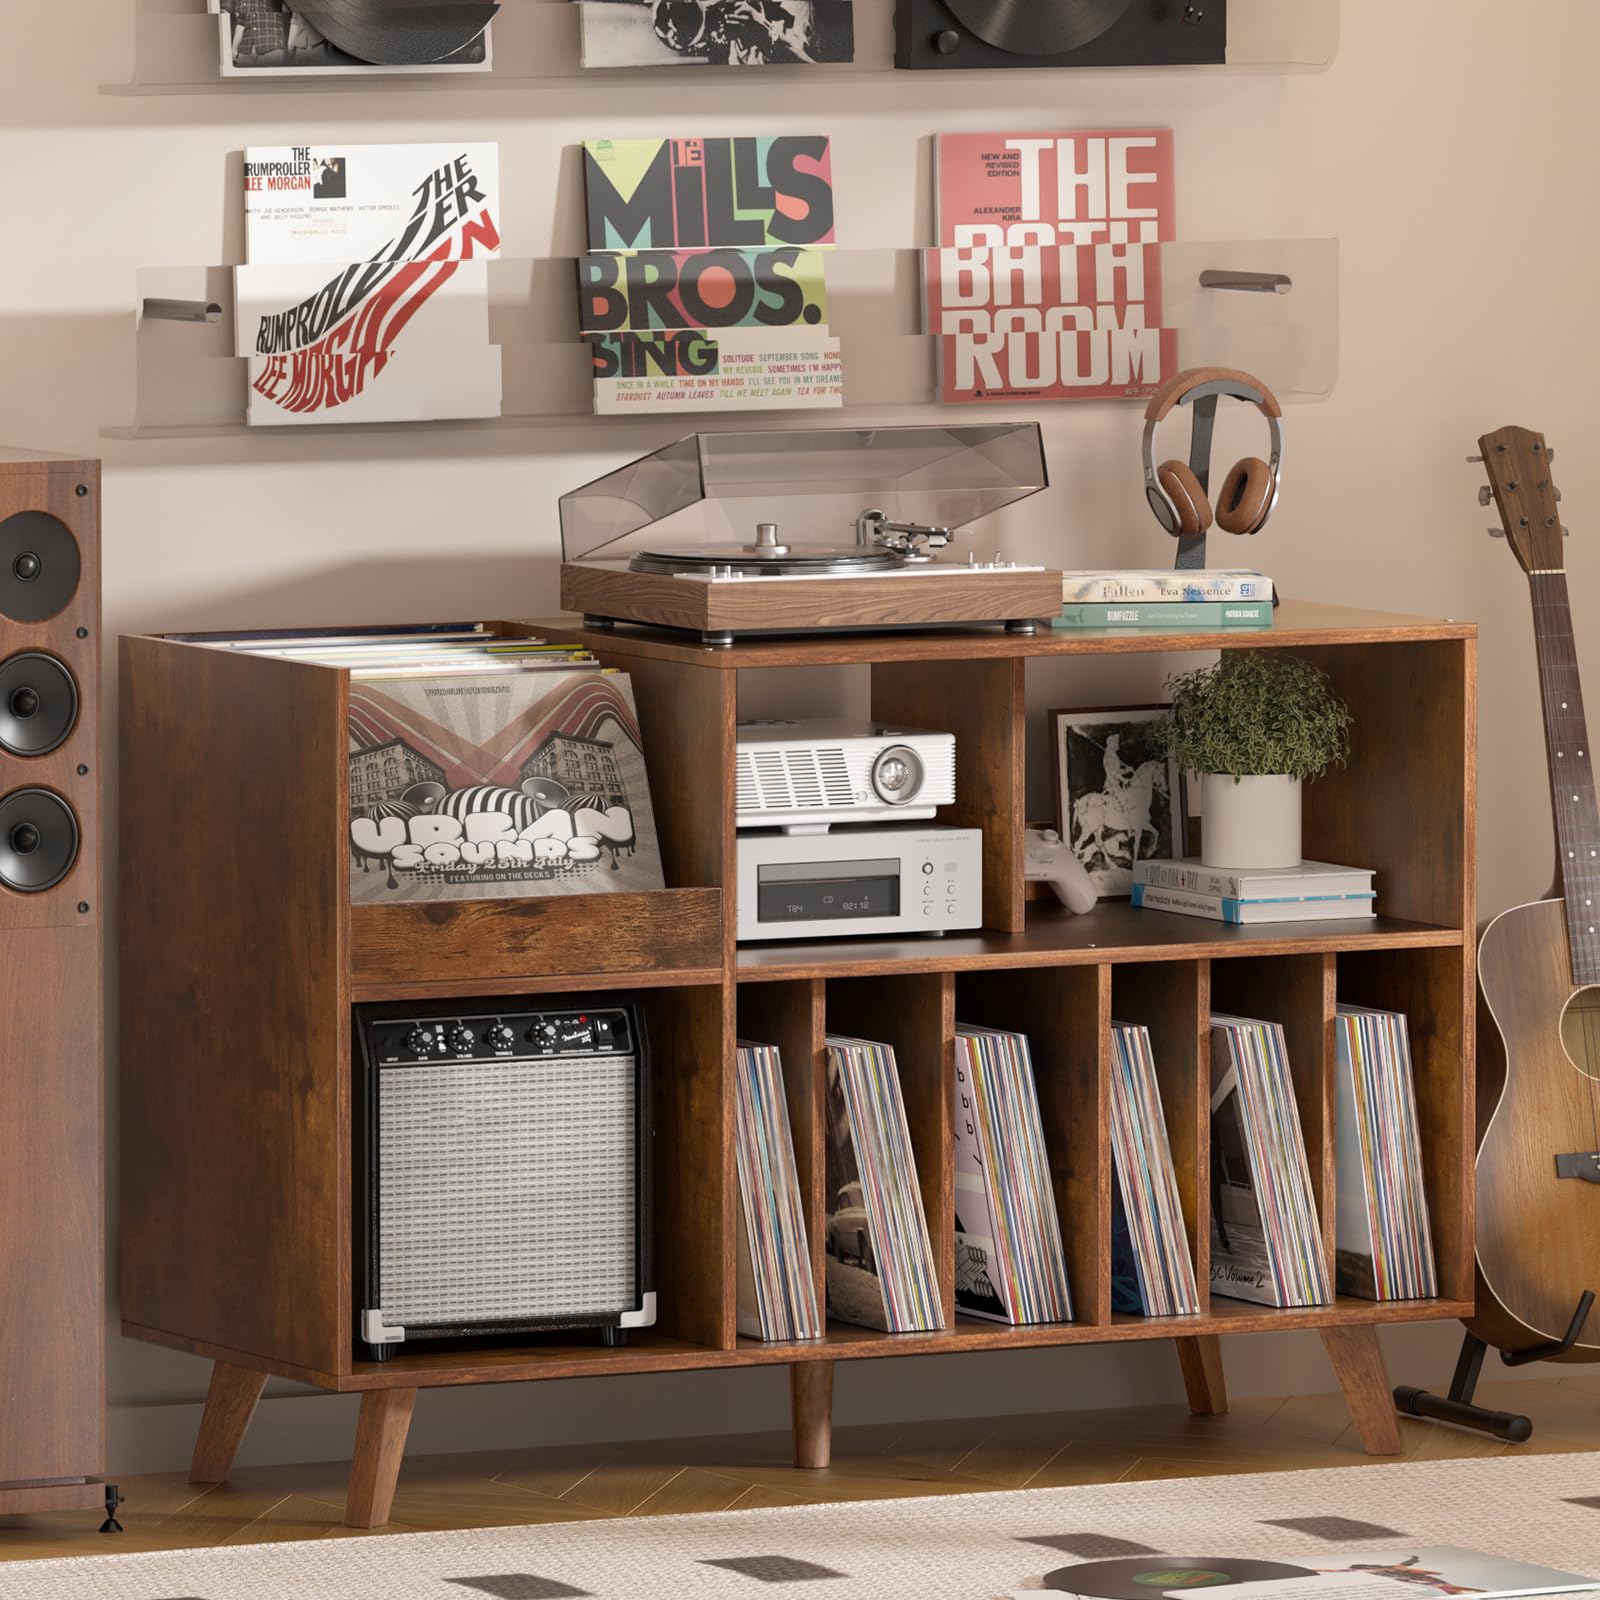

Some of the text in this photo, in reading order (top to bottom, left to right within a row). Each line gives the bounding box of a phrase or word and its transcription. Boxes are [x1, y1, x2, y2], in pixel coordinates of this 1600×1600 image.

[291, 147, 311, 161] THE
[247, 162, 311, 176] RUMPROLLER
[985, 161, 1020, 169] REVISED
[245, 175, 311, 191] LEE MORGAN
[1005, 137, 1158, 221] THE
[408, 152, 473, 223] THE
[585, 136, 835, 249] MILLS
[973, 206, 1021, 214] ALEXANDER
[940, 221, 1158, 308] BATH
[579, 246, 822, 332] BROS.
[582, 328, 719, 378] SING
[941, 304, 1160, 390] ROOM
[722, 353, 754, 363] SOLITUDE
[759, 352, 798, 361] SEPTEMBER
[801, 352, 819, 360] SONG
[723, 366, 733, 374] MY
[768, 364, 806, 373] SOMETIMES
[252, 354, 288, 401] LEE
[616, 381, 634, 390] ONCE
[636, 381, 644, 389] IN
[646, 380, 651, 388] A
[655, 380, 674, 389] WHILE
[679, 379, 694, 388] TIME
[697, 379, 707, 387] ON
[709, 379, 719, 387] MY
[722, 378, 745, 386] HANDS
[763, 376, 775, 384] SEE
[779, 376, 791, 384] YOU
[794, 376, 801, 384] IN
[803, 375, 813, 384] MY
[616, 392, 652, 401] STARDUST
[656, 391, 686, 400] AUTUMN
[689, 390, 714, 399] LEAVES
[737, 389, 747, 397] WE
[751, 388, 769, 397] MEET
[772, 388, 792, 396] AGAIN
[797, 387, 810, 396] TEA
[813, 386, 826, 395] FOR
[1160, 588, 1178, 596] Eva
[1182, 586, 1231, 596] Nessence
[350, 806, 637, 855] URBAN
[391, 835, 602, 869] SOUNDS
[414, 856, 576, 875] Friday 25th July
[450, 870, 551, 882] FEATURING ON THE DECKS
[823, 896, 834, 904] CD
[1255, 1271, 1265, 1288] 2
